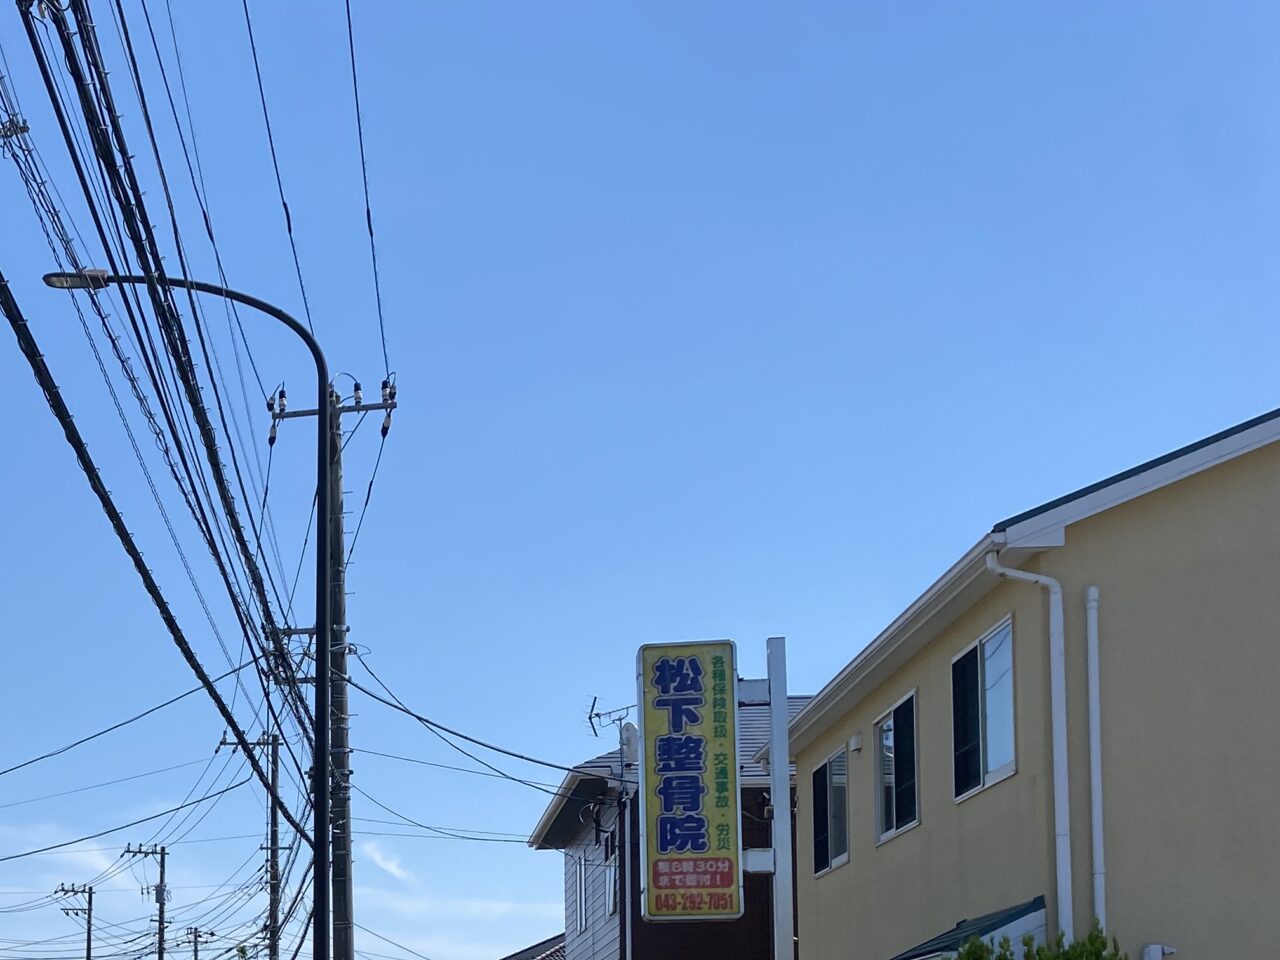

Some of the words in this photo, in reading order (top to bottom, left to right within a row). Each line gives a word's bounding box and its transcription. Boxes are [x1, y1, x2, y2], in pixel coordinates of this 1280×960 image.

[653, 656, 709, 854] 松下整骨院
